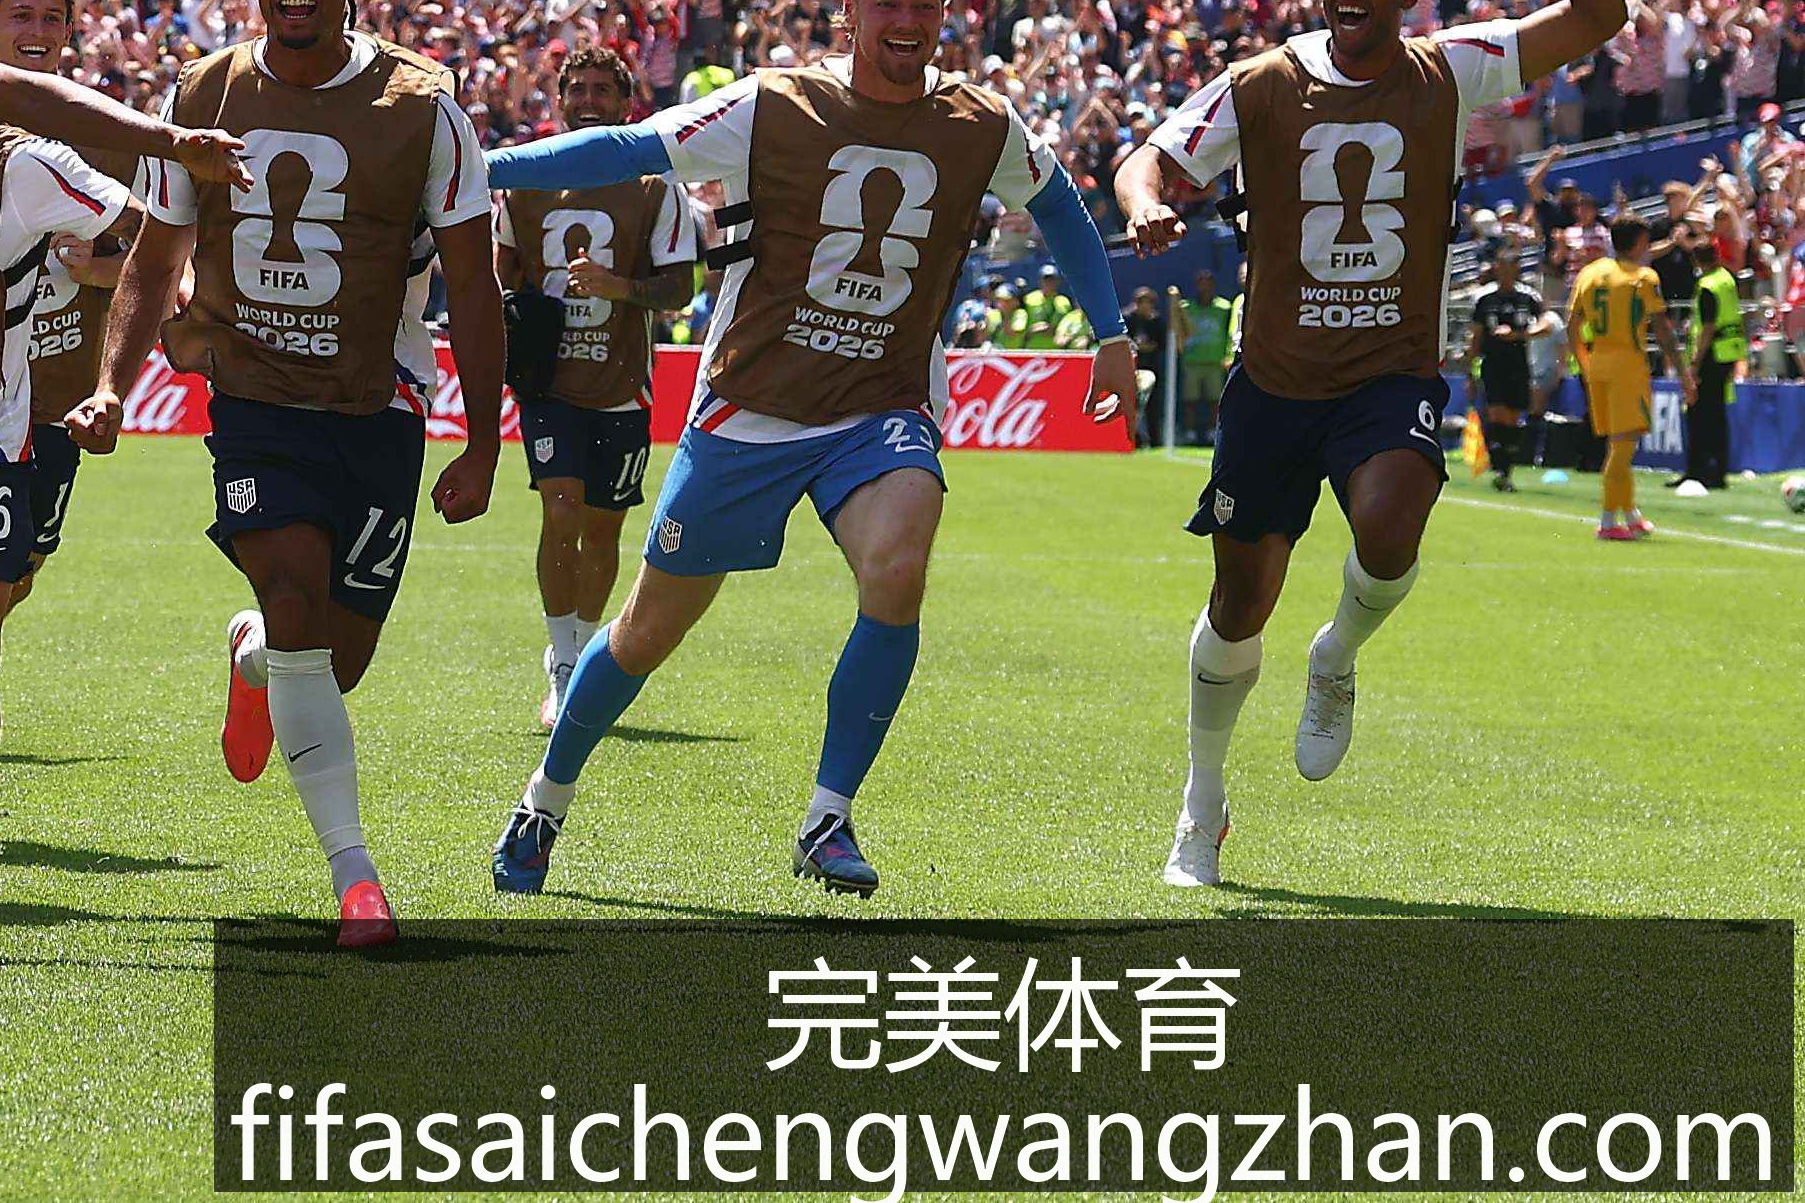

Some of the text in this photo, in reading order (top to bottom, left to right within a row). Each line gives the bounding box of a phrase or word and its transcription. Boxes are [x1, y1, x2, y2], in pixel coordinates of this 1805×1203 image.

[1331, 251, 1378, 268] FIFA
[259, 269, 310, 290] FIFA
[835, 277, 882, 301] FIFA
[1301, 286, 1401, 302] WORLD CUP
[52, 311, 82, 331] CUP
[235, 303, 340, 329] WORLD CUP
[795, 306, 895, 337] WORLD CUP
[1299, 303, 1401, 328] 2026
[584, 331, 610, 342] CUP
[783, 324, 885, 360] 2026
[557, 342, 609, 363] 026
[1418, 400, 1436, 432] 6
[615, 447, 645, 490] 10
[228, 480, 254, 495] USA
[346, 507, 406, 578] 12
